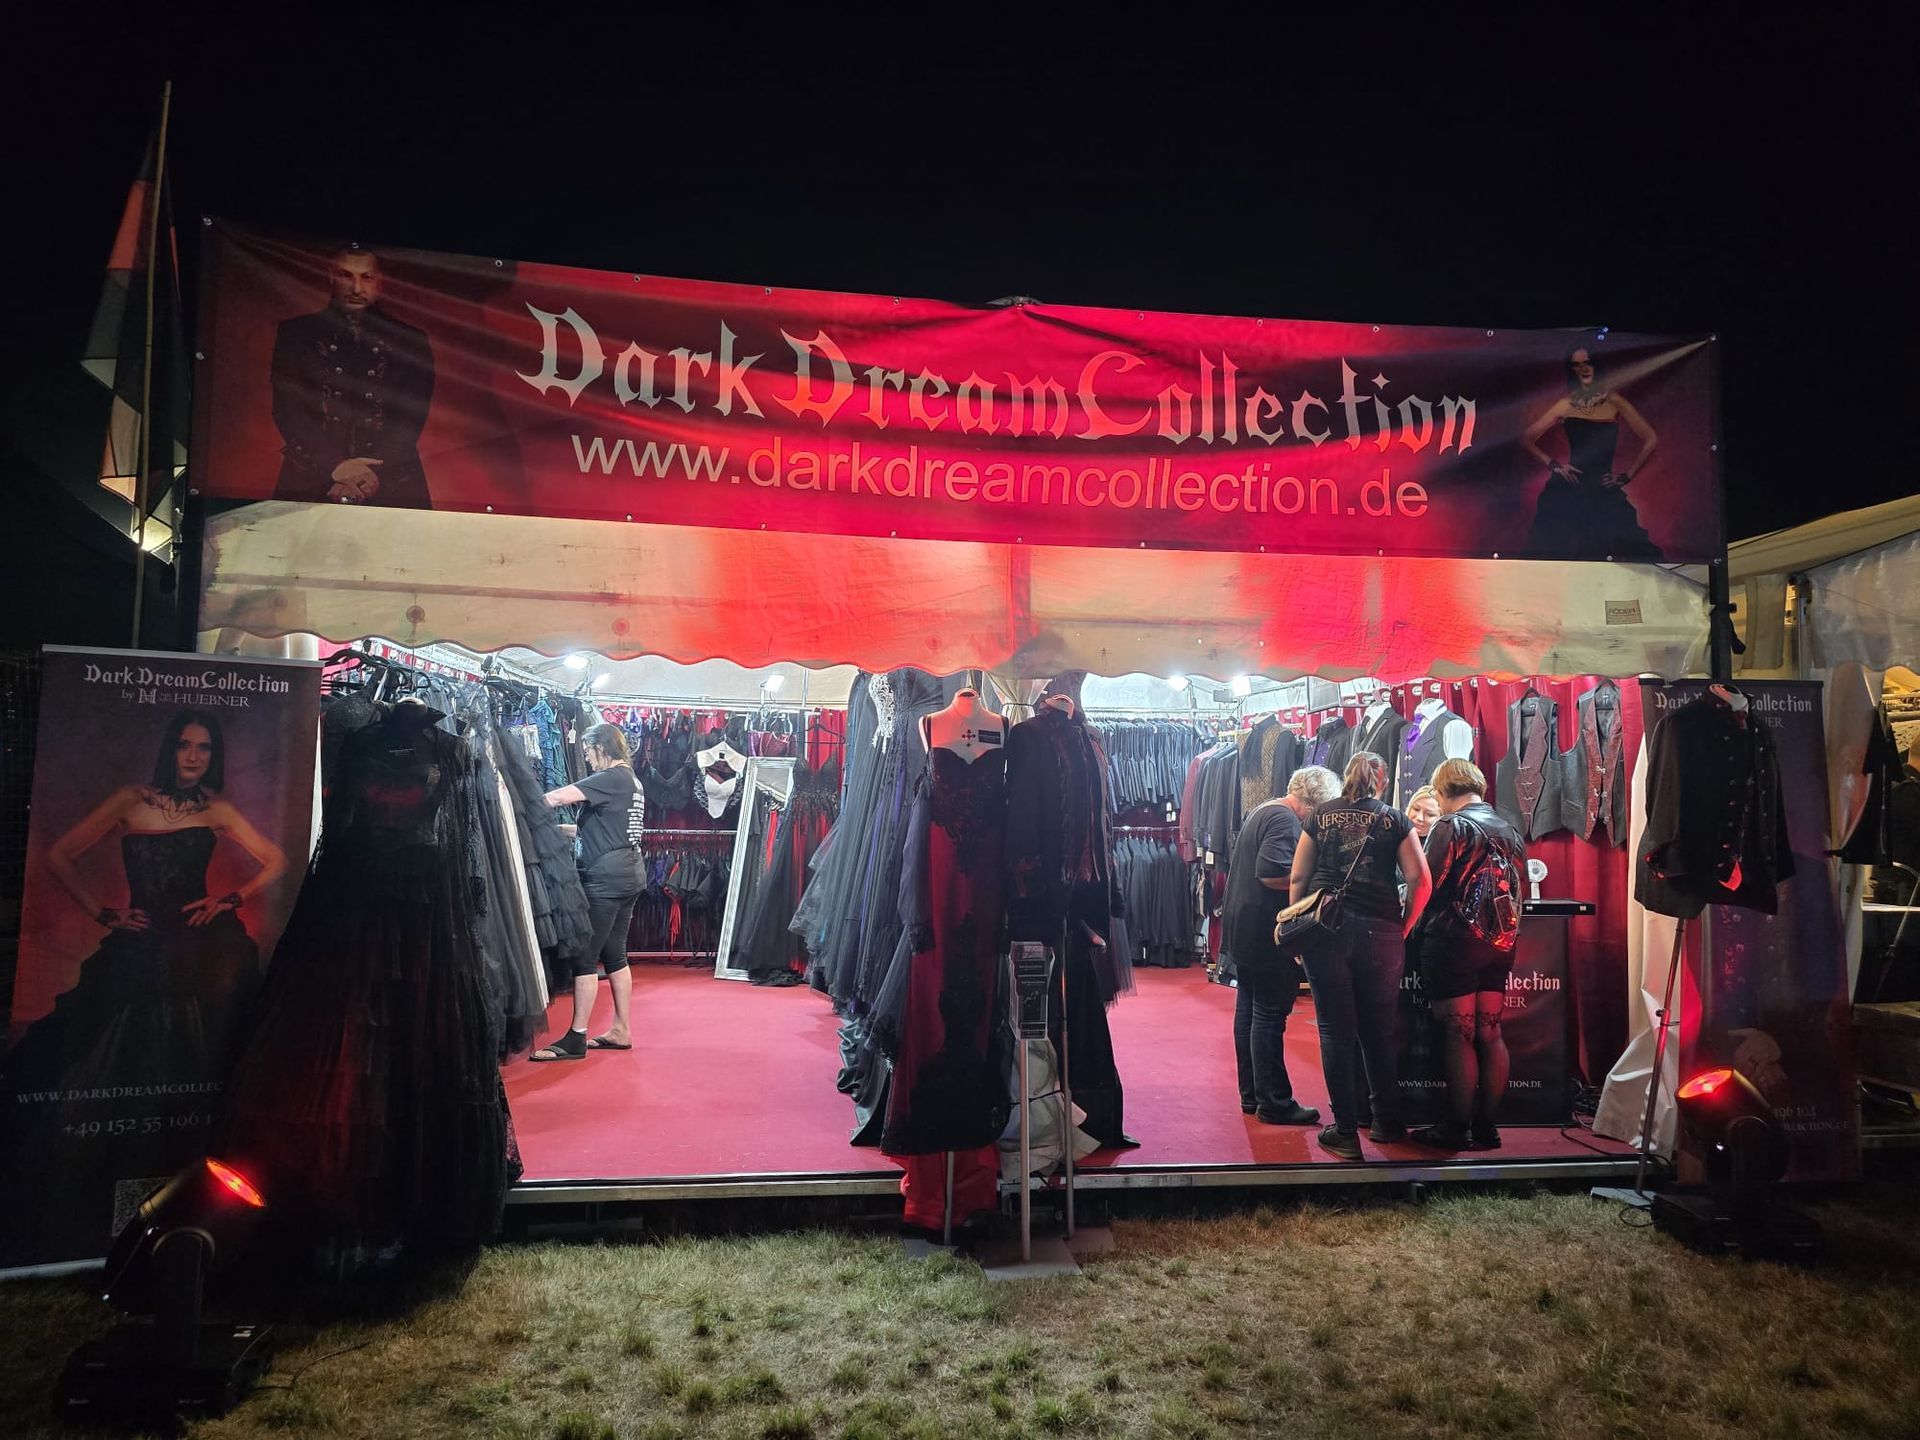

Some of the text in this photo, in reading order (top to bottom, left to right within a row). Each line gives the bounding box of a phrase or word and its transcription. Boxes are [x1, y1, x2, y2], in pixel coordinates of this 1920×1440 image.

[515, 301, 766, 419] Dark
[571, 434, 1429, 518] www.darkdreamcollection.de
[83, 663, 136, 686] Dark
[121, 688, 135, 701] by
[173, 692, 250, 708] HUEBNER
[1316, 811, 1393, 831] VERSENGOD
[16, 1080, 224, 1105] WWW.DARKDREAMCOLLEC
[61, 1120, 101, 1138] +49
[105, 1117, 137, 1136] 152
[141, 1116, 162, 1135] 55
